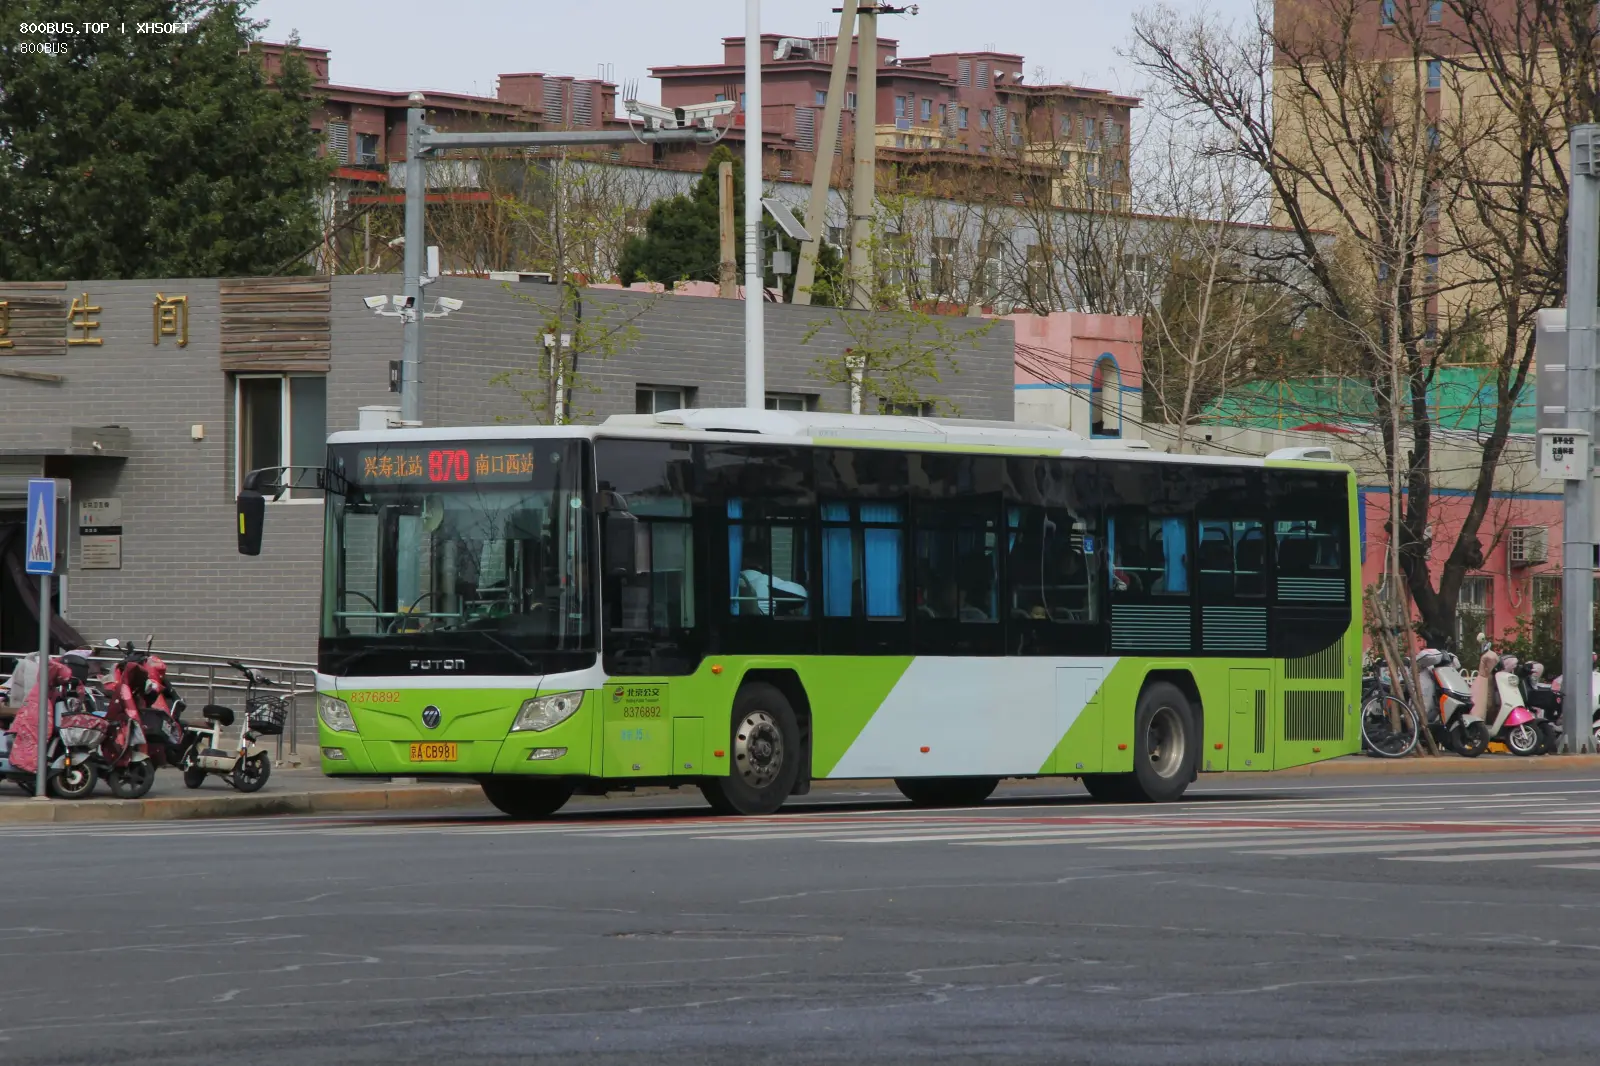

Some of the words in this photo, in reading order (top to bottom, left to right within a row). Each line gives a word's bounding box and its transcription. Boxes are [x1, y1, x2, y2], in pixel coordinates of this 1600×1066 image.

[364, 455, 424, 478] 兴寿北站
[427, 449, 470, 482] 870
[474, 452, 535, 476] 南口西站
[409, 659, 465, 670] FOTON
[350, 691, 400, 703] 8376892
[626, 688, 660, 697] 北京公交
[623, 706, 661, 718] 8376892
